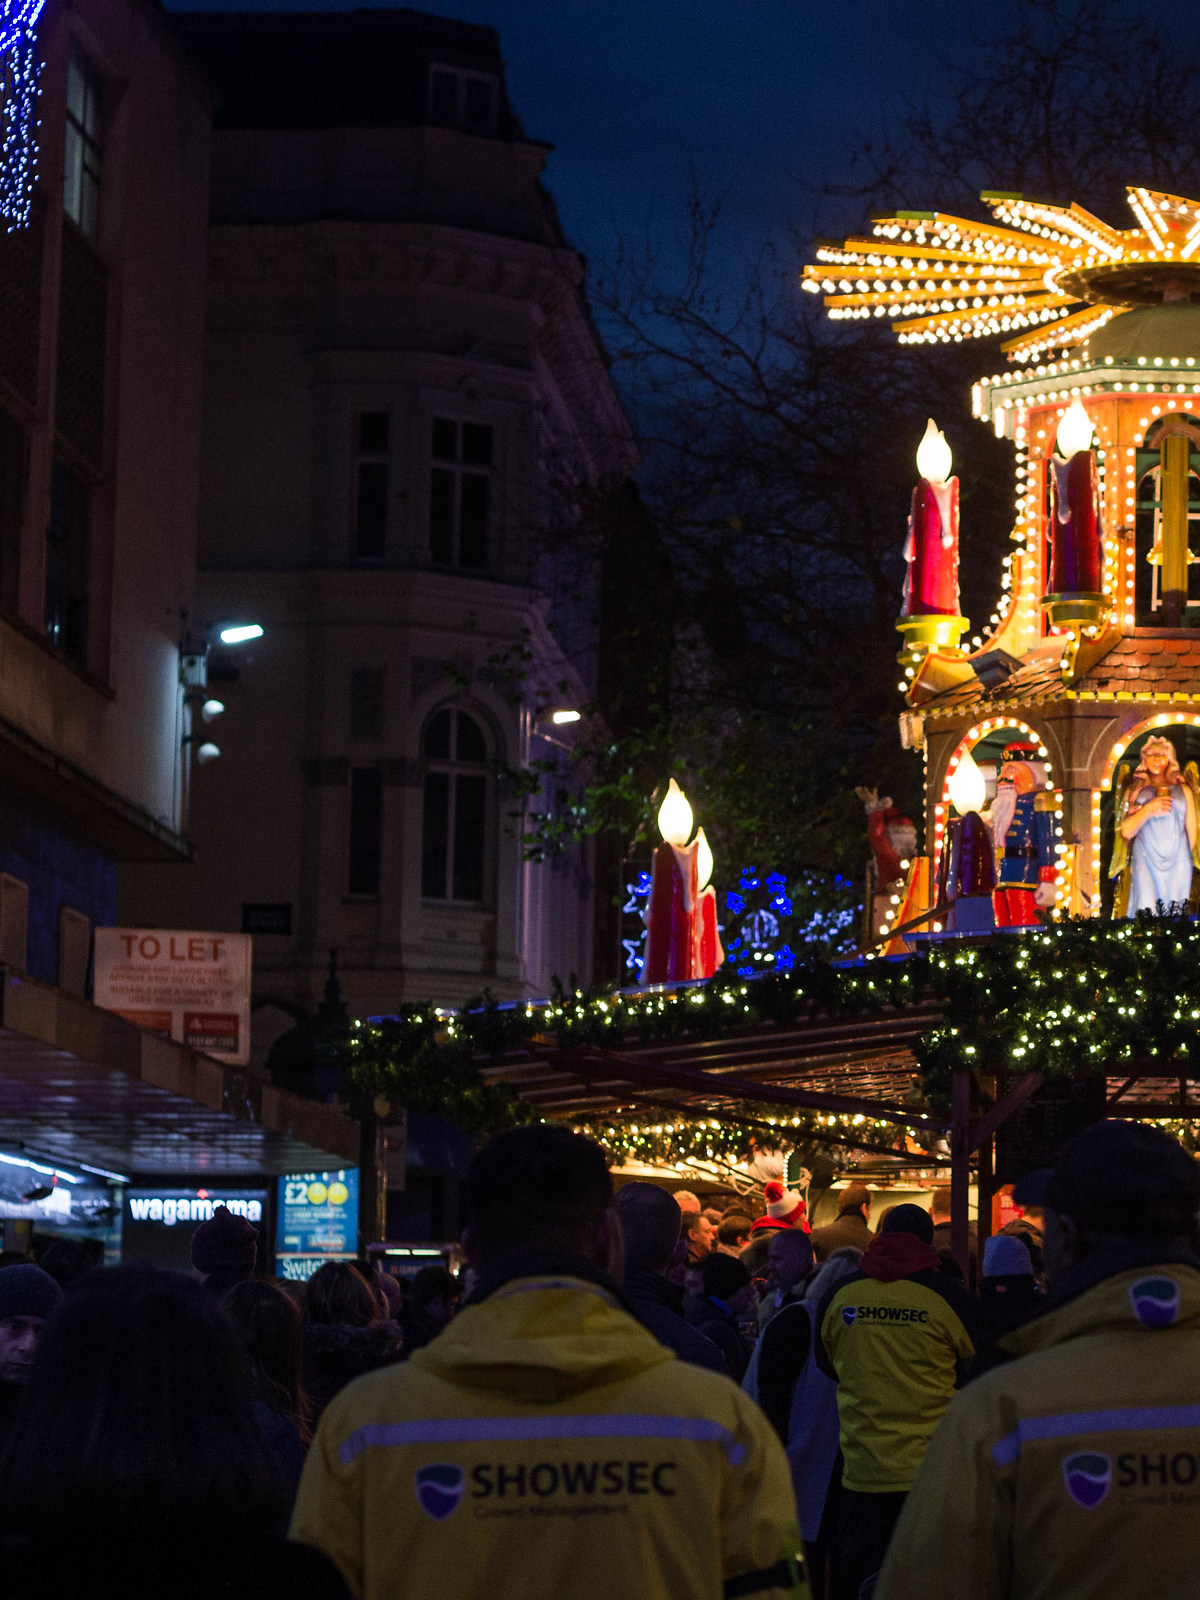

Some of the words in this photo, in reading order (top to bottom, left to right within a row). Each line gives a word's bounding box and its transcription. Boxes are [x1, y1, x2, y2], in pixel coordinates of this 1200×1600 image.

[121, 935, 160, 960] TO
[169, 937, 224, 962] LET
[857, 1306, 929, 1323] SHOWSEC
[471, 1461, 678, 1499] SHOWSEC
